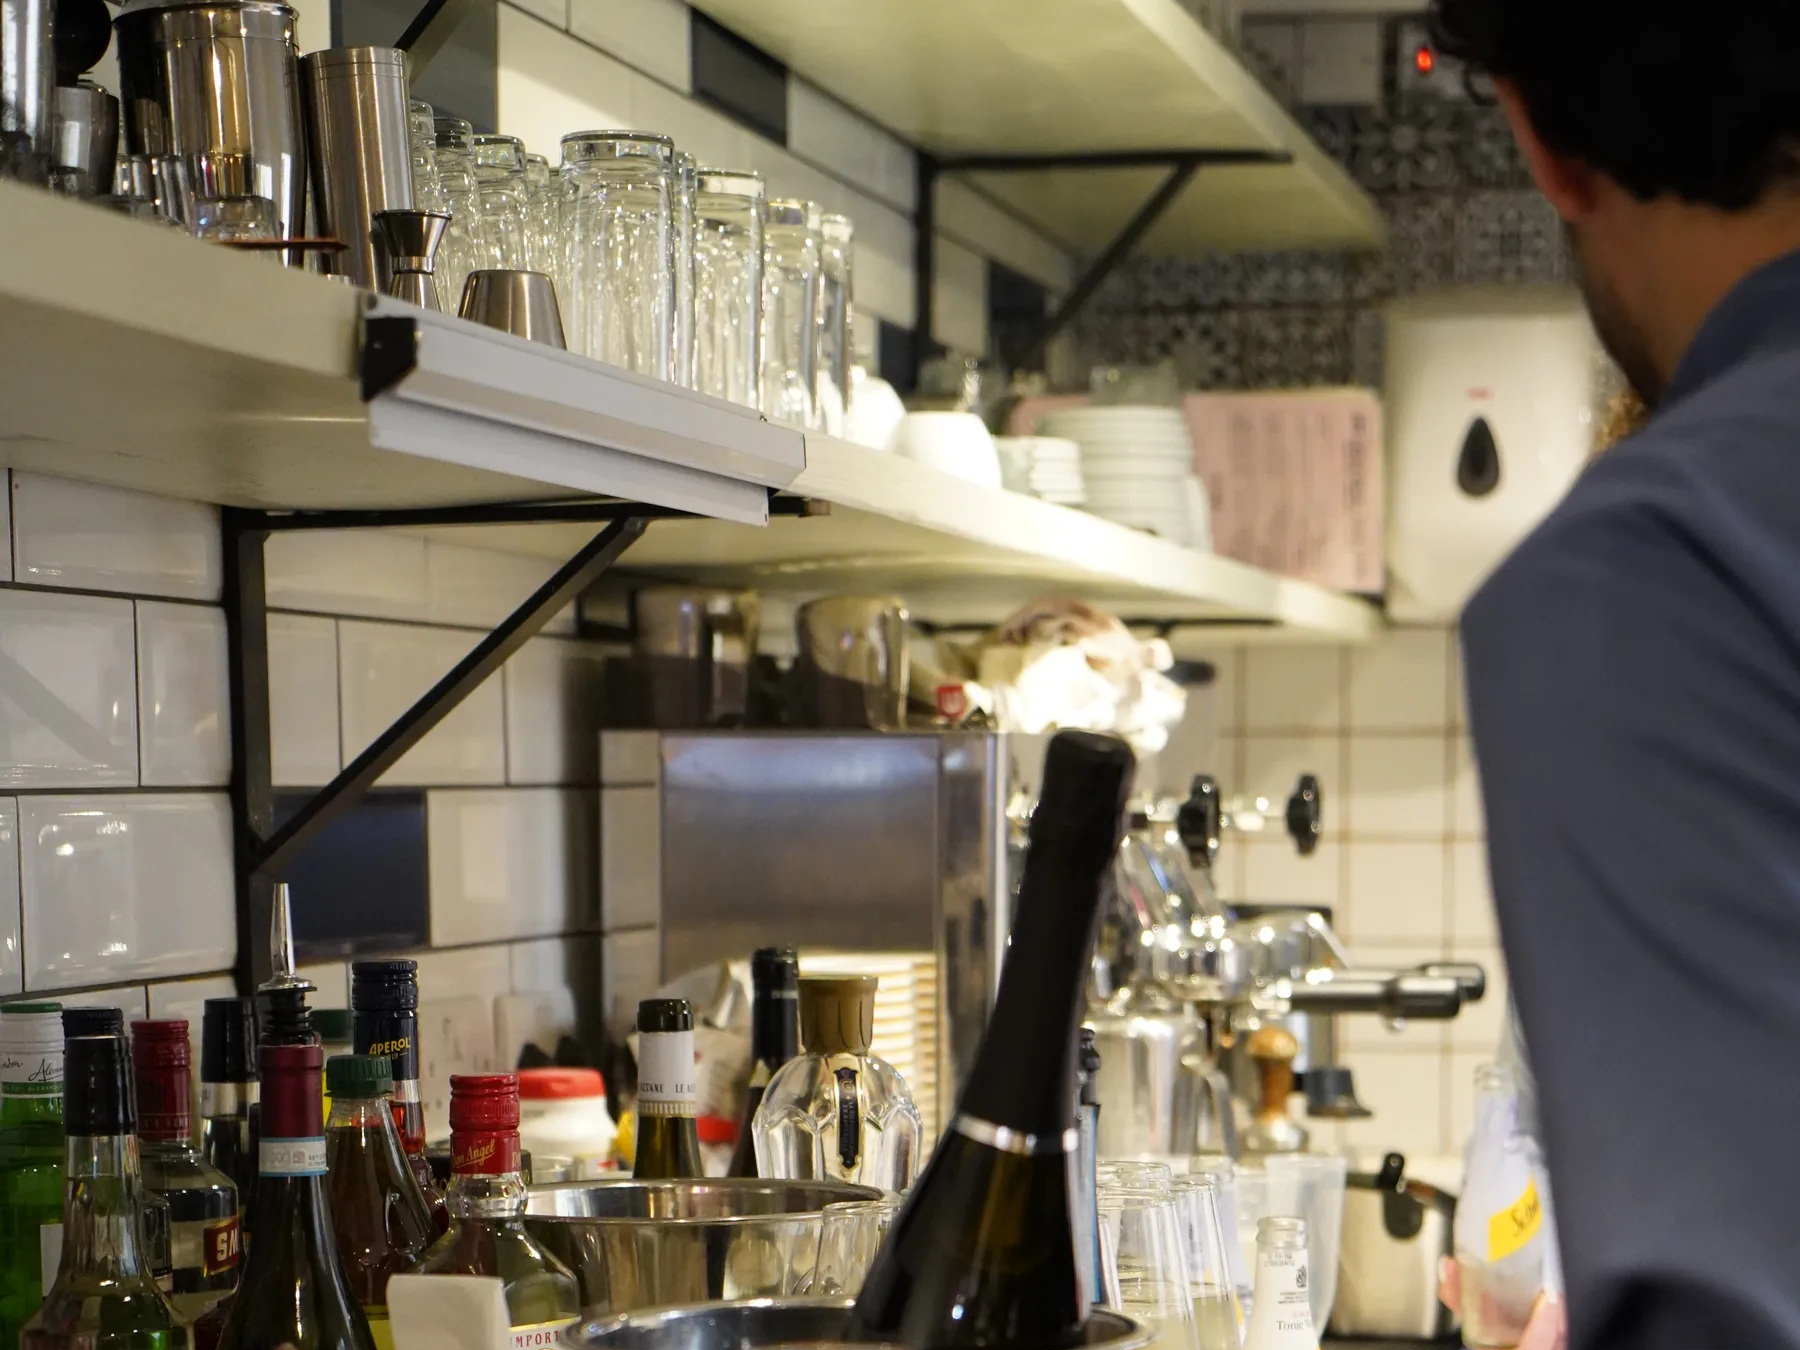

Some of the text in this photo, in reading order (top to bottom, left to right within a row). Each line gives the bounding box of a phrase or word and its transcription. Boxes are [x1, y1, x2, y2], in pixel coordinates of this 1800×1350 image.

[369, 1036, 411, 1056] APEROL
[466, 1138, 496, 1166] Angel
[1276, 1320, 1303, 1331] Tonic
